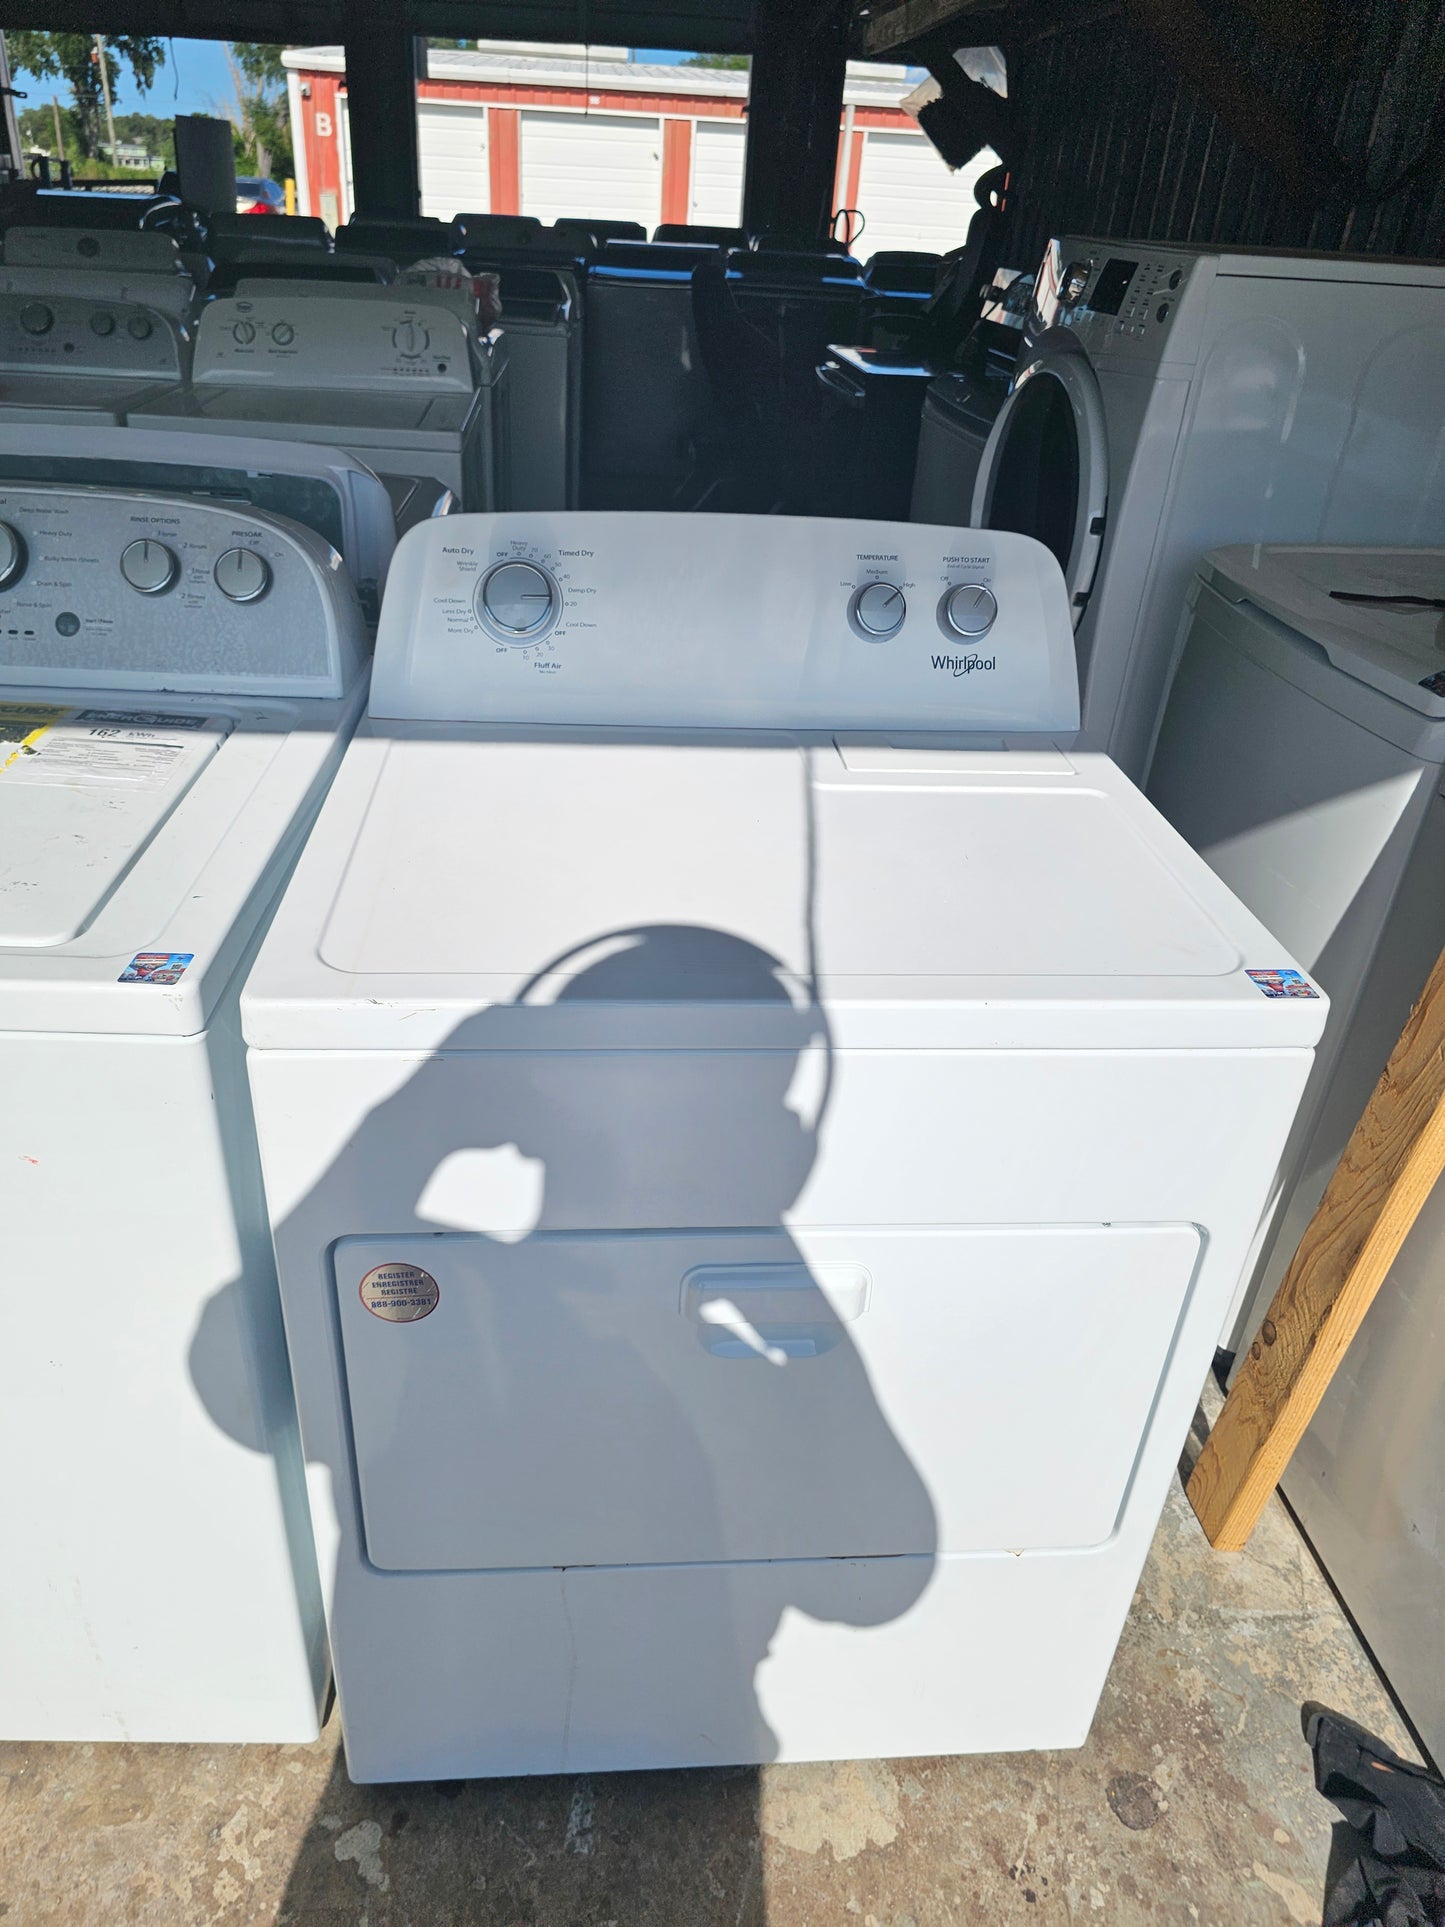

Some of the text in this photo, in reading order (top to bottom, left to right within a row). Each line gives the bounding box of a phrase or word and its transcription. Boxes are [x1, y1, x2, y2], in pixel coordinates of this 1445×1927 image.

[316, 112, 332, 136] B
[931, 654, 996, 676] Whirlpool
[89, 728, 121, 737] 162
[372, 1280, 424, 1288] ENREGISTRER
[371, 1299, 431, 1308] 888-900-3381
